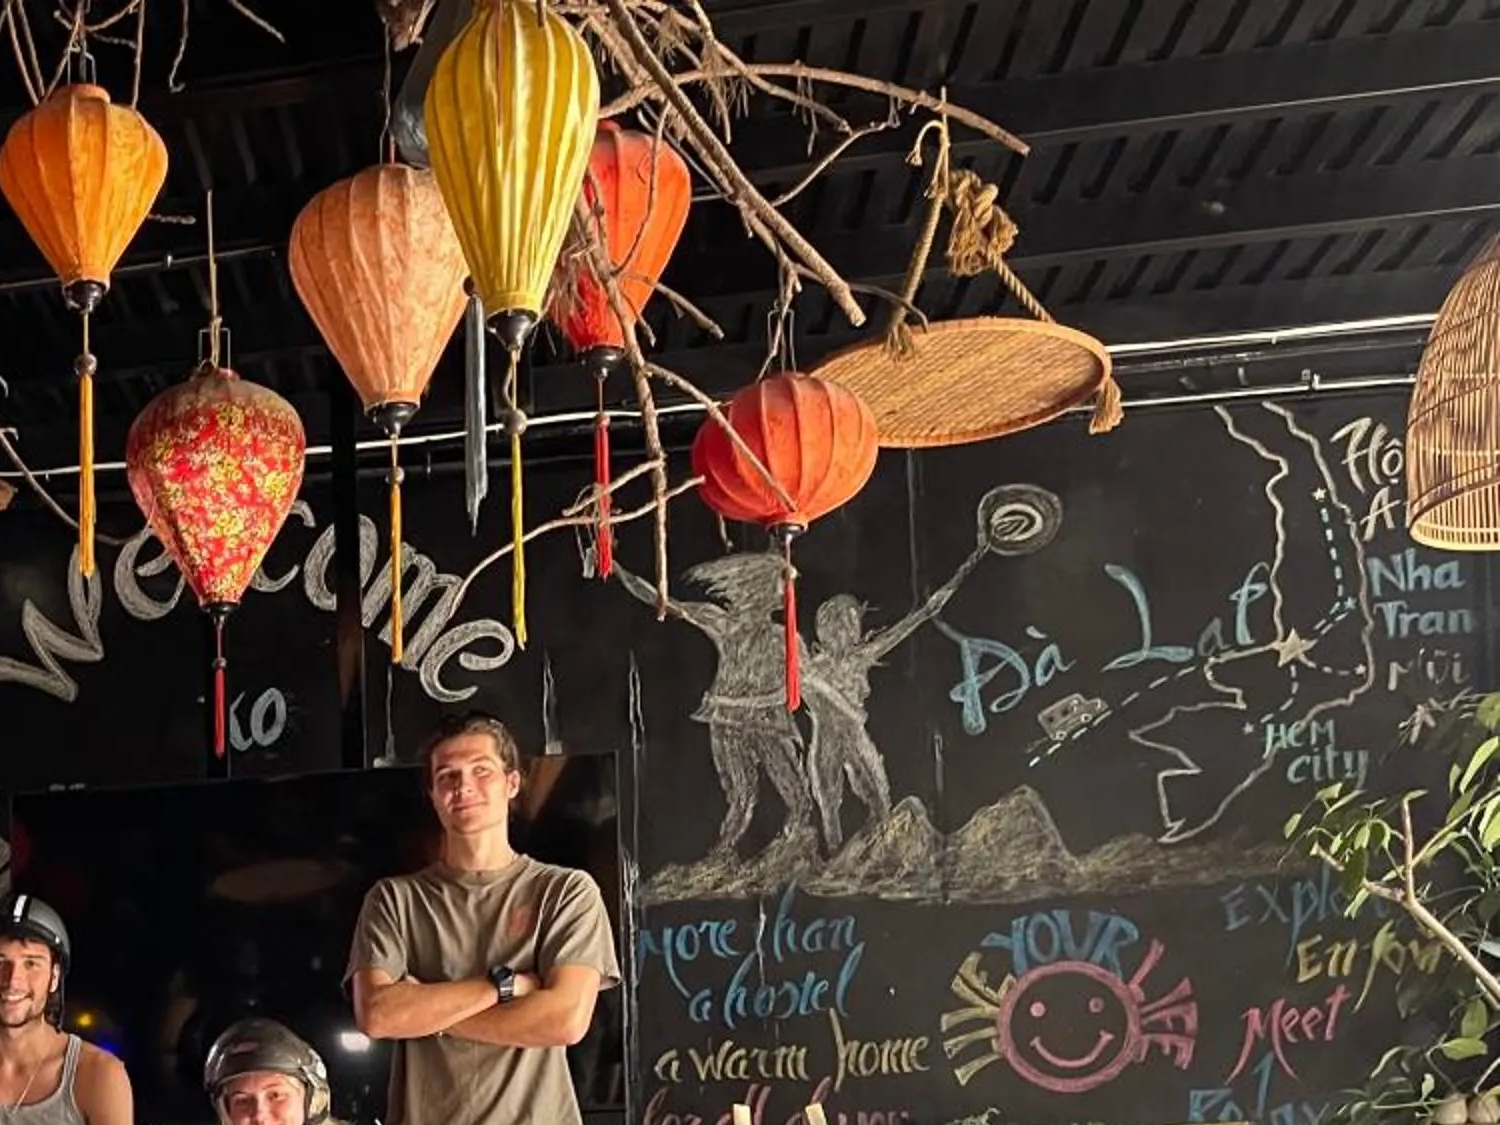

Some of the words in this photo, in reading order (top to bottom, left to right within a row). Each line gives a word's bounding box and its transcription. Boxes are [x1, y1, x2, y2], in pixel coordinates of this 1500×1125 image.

[1330, 417, 1405, 494] Hộ
[1366, 547, 1466, 596] Nha
[980, 909, 1139, 978] YOUR
[689, 987, 715, 1023] a
[1224, 985, 1351, 1086] Meet
[654, 1050, 682, 1083] a
[828, 1007, 932, 1094] home
